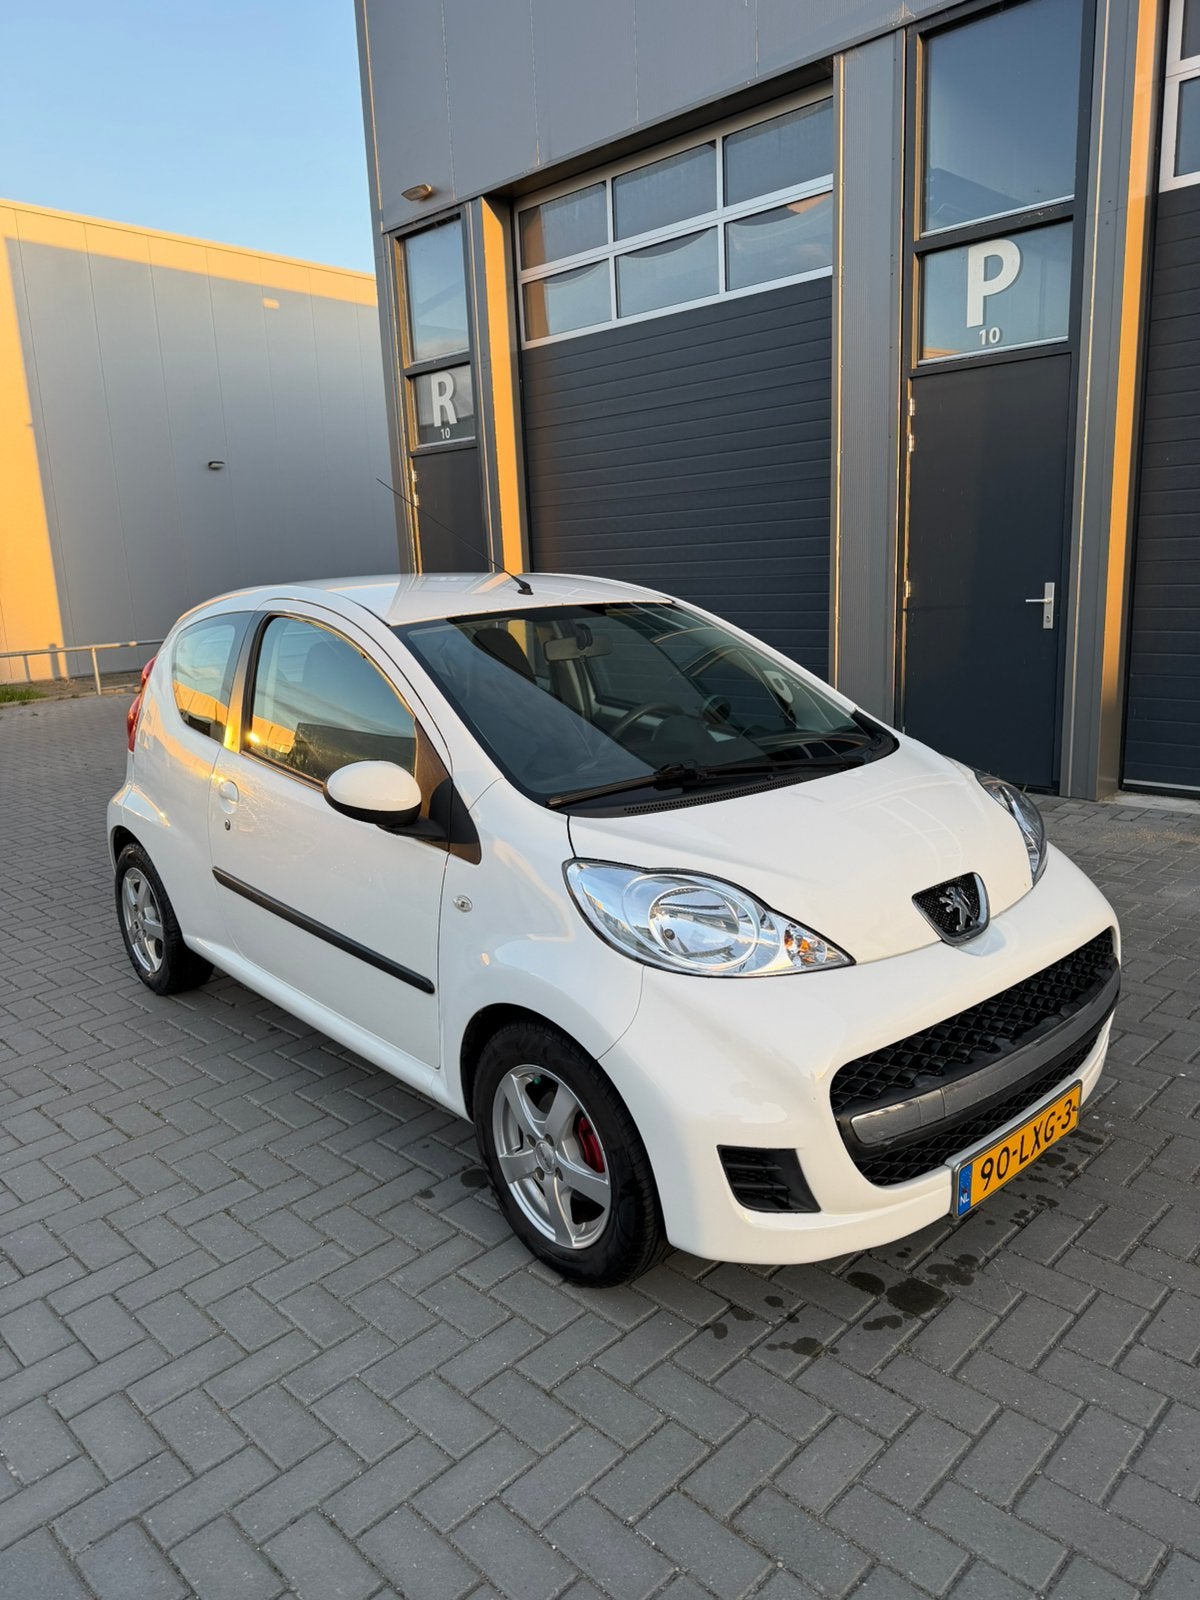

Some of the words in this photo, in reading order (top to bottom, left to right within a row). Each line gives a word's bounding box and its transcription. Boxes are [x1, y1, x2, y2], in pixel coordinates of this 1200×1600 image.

[966, 239, 1021, 328] P
[979, 326, 1001, 345] 10
[431, 371, 457, 427] R
[440, 427, 451, 439] 10
[980, 1098, 1073, 1191] 90-LXG-3
[959, 1192, 970, 1206] NL
